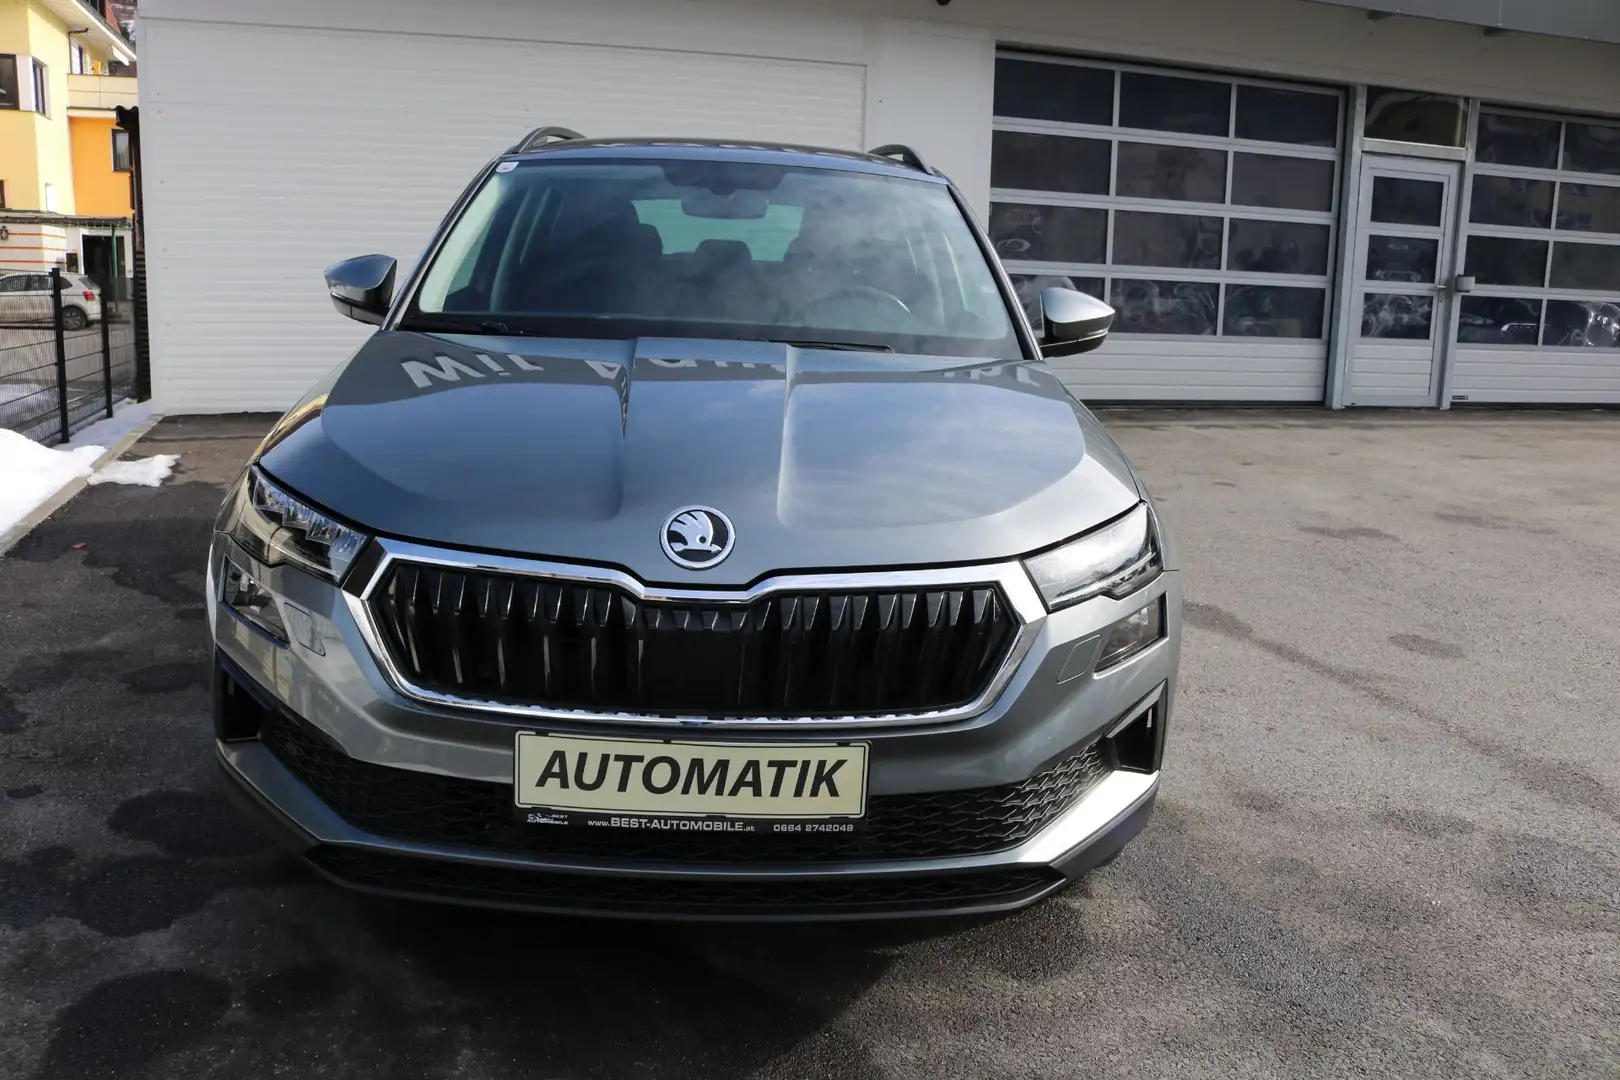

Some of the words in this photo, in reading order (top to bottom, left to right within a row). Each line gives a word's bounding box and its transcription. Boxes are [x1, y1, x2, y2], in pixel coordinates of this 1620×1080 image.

[535, 750, 849, 798] AUTOMATIK
[587, 817, 755, 832] www.BEST-AUTOMOBILE.at
[805, 823, 854, 832] 2742048
